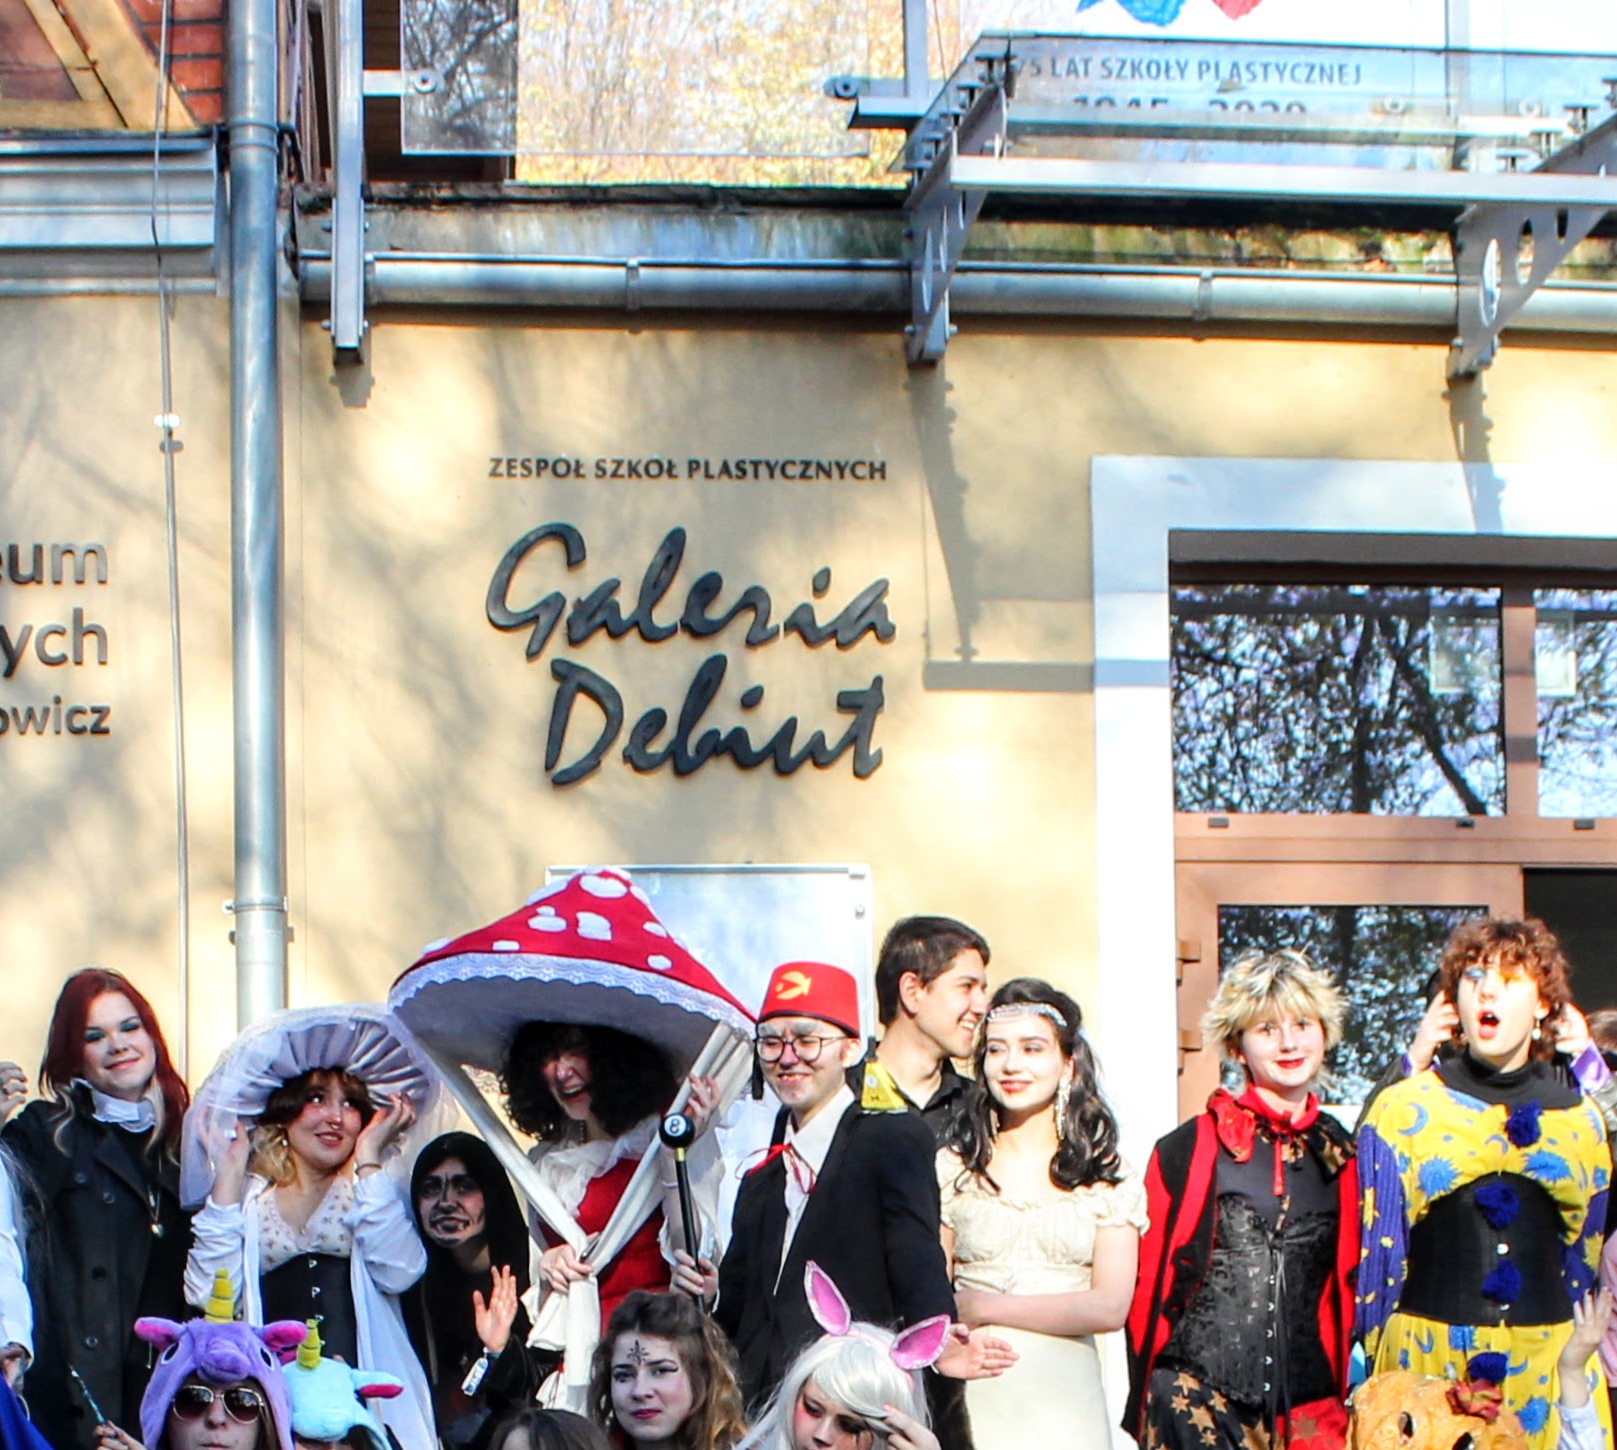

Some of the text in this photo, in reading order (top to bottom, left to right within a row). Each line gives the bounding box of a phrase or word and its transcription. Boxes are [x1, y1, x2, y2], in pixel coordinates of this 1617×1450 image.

[1050, 57, 1092, 78] LAT
[1100, 56, 1190, 81] SZKOŁY
[1196, 60, 1362, 86] PLASTYCZNEJ
[687, 459, 886, 481] PLASTYCZNYCH
[486, 522, 896, 661] Galeria
[544, 653, 885, 786] Debiut
